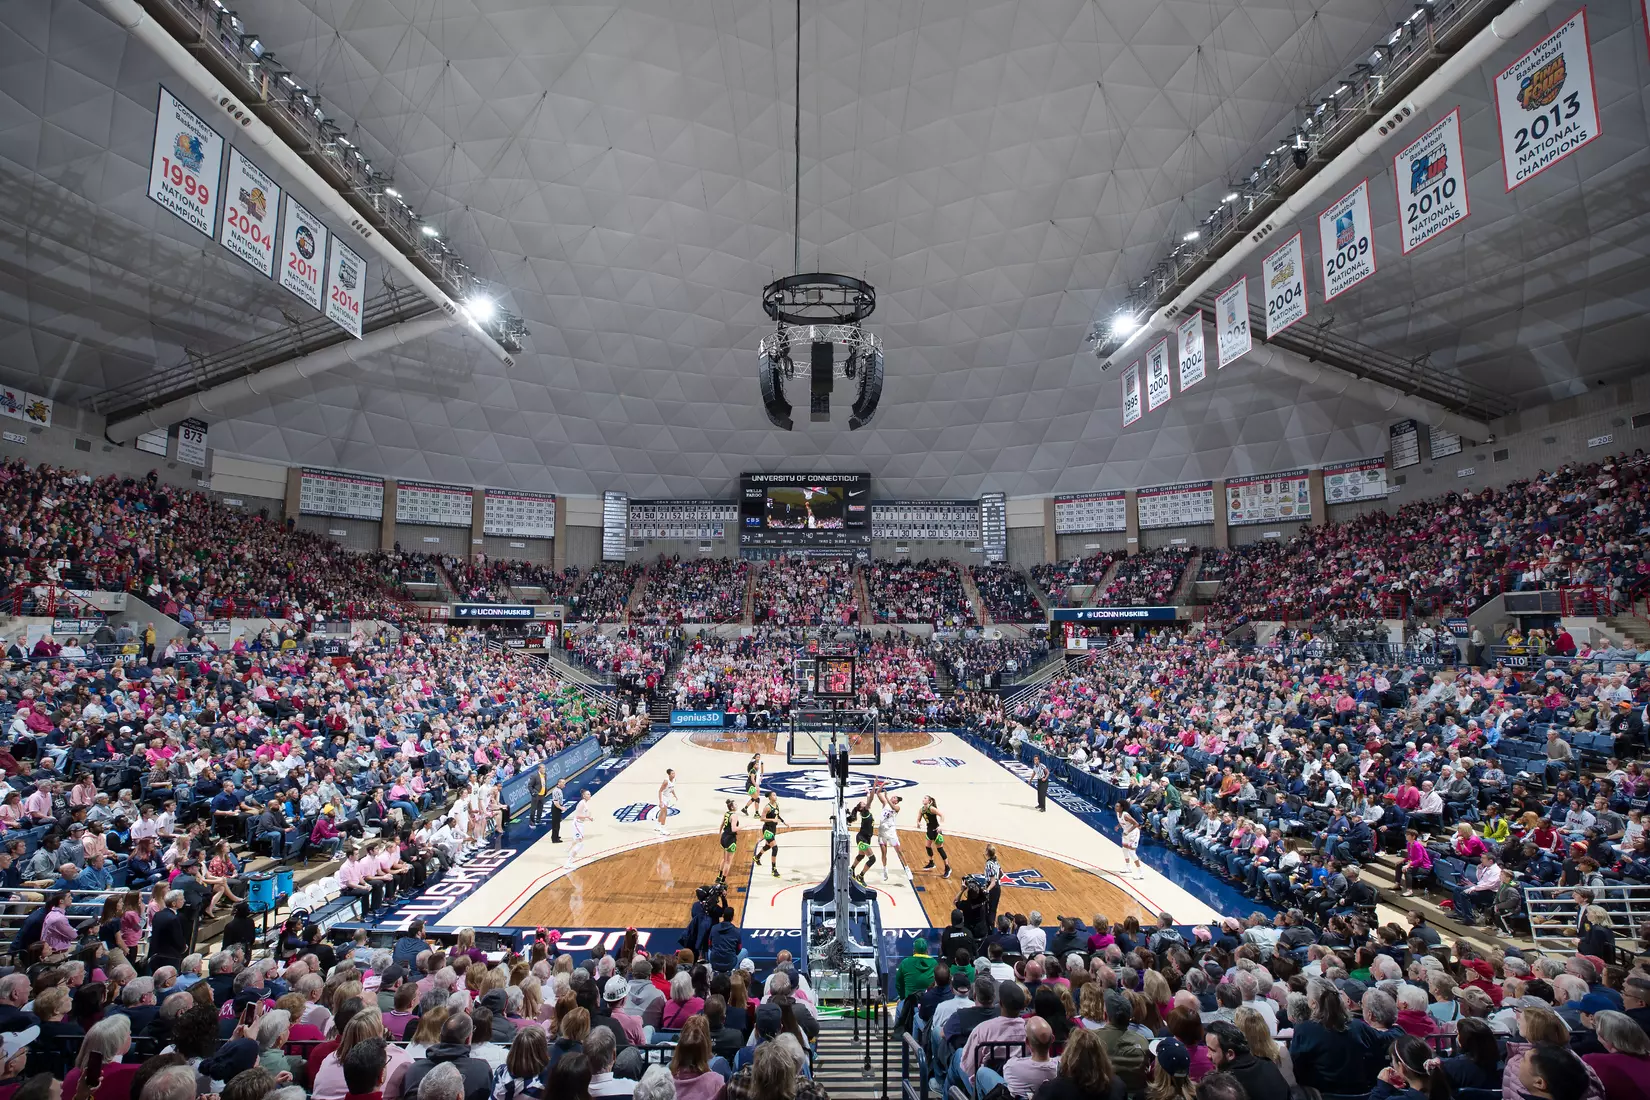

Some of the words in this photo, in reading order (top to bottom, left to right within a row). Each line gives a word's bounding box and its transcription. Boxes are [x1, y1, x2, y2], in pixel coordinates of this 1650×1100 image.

[1502, 56, 1530, 80] UConn
[1532, 21, 1575, 56] Women's
[1517, 41, 1562, 81] Basketball
[173, 99, 194, 121] UConn
[195, 119, 213, 137] Men's
[176, 113, 208, 143] Basketball
[1514, 91, 1581, 154] 2013
[1400, 142, 1420, 159] UConn
[1422, 116, 1452, 142] Women's
[1410, 133, 1442, 161] Basketball
[1519, 122, 1580, 165] NATIONAL
[1516, 130, 1588, 180] CHAMPIONS
[162, 157, 209, 205] 1999
[240, 157, 258, 175] UConn
[259, 173, 272, 187] Men's
[242, 168, 268, 193] Basketball
[157, 192, 207, 231] CHAMPIONS
[162, 181, 205, 217] NATIONAL
[295, 203, 308, 220] UConn
[1323, 206, 1338, 219] UConn
[1340, 186, 1362, 207] Women's
[1330, 199, 1355, 222] Basketball
[1408, 178, 1456, 224] 2010
[228, 207, 271, 251] 2004
[296, 213, 318, 234] Basketball
[1410, 210, 1460, 246] CHAMPIONS
[1412, 202, 1455, 234] NATIONAL
[227, 240, 267, 271] CHAMPIONS
[232, 230, 265, 260] NATIONAL
[1272, 248, 1292, 267] Basketball
[1327, 236, 1368, 277] 2009
[289, 252, 317, 284] 2011
[1330, 267, 1369, 295] CHAMPIONS
[1332, 260, 1365, 284] NATIONAL
[284, 279, 317, 306] CHAMPIONS
[288, 270, 315, 295] NATIONAL
[332, 285, 359, 315] 2014
[1269, 282, 1302, 316] 2004
[1273, 303, 1299, 323] NATIONAL
[330, 312, 357, 333] CHAMPIONS
[332, 303, 356, 324] NATIONAL
[1272, 311, 1302, 332] CHAMPIONS
[1182, 351, 1202, 373] 2002
[1150, 374, 1168, 395] 2000
[1125, 395, 1138, 412] 1995
[184, 429, 202, 443] 873
[1251, 471, 1304, 481] CHAMPIONSHIP
[1345, 458, 1384, 468] CHAMPION
[1160, 482, 1208, 491] CHAMPIONSHIP
[1422, 656, 1435, 664] 109
[1510, 657, 1524, 665] 110
[832, 674, 846, 692] 12
[677, 714, 719, 723] genius3D
[380, 849, 517, 931] HUSKIES
[751, 929, 802, 938] ourt
[882, 929, 922, 938] Alu
